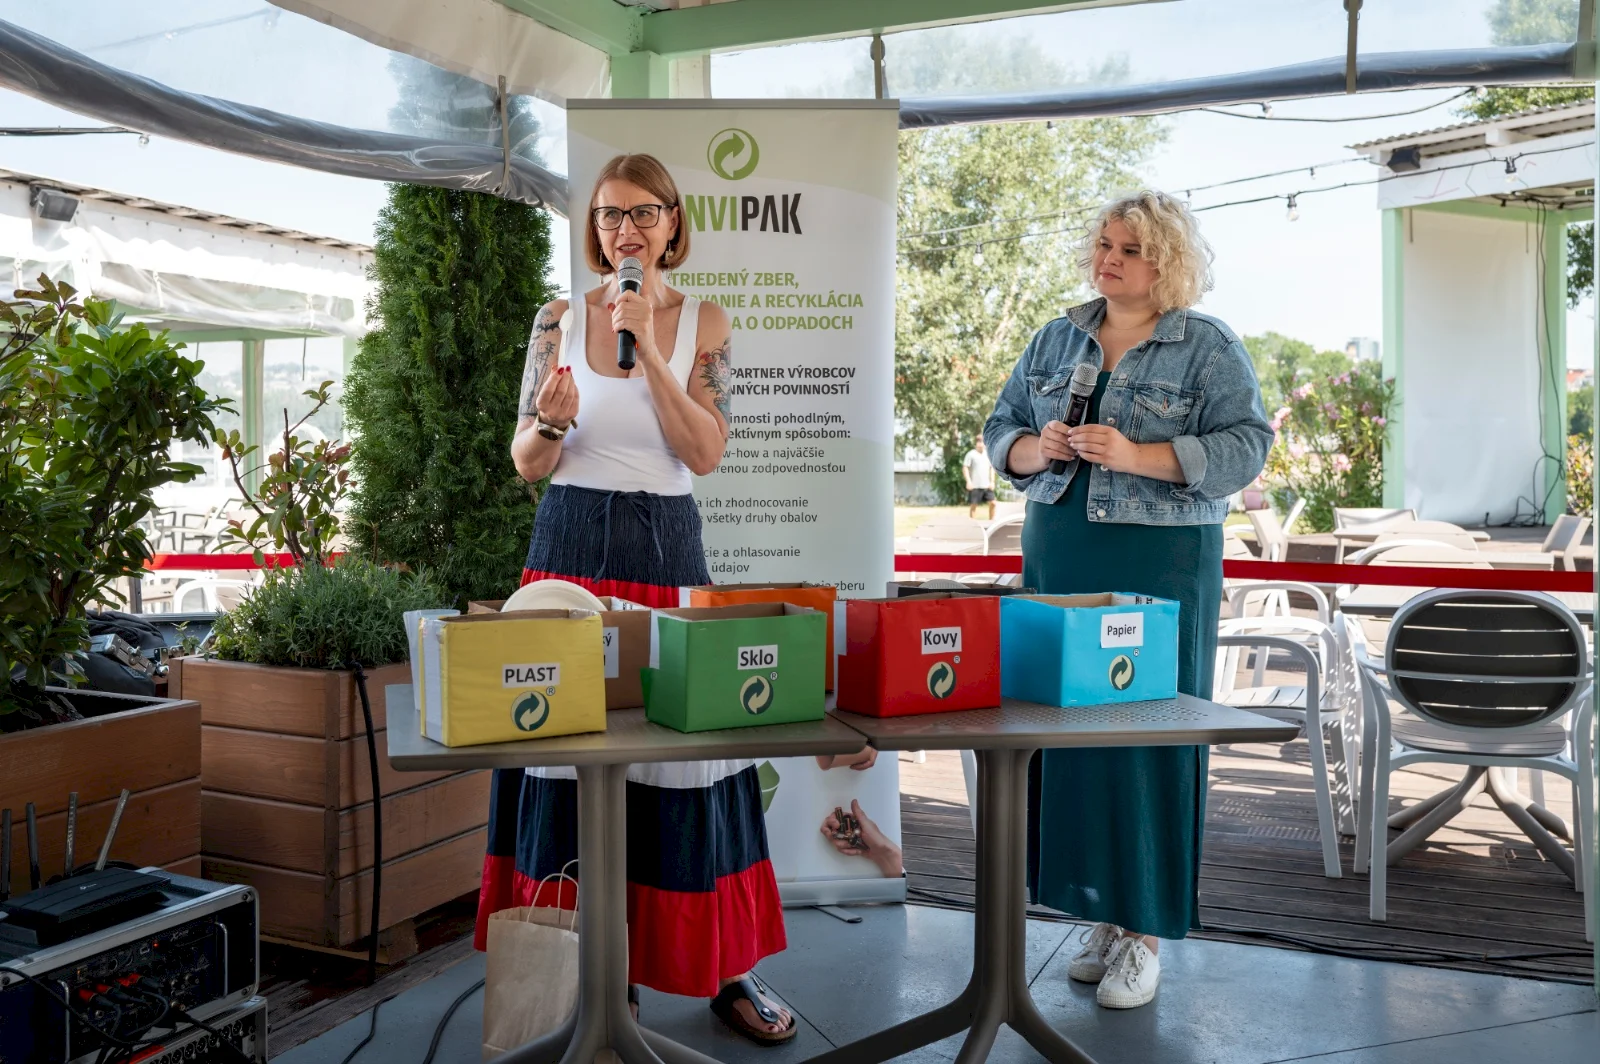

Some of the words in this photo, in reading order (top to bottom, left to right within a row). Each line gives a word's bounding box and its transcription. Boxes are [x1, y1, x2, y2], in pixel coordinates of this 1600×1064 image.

[753, 272, 799, 289] ZBER,
[750, 294, 761, 308] A
[765, 289, 863, 308] RECYKLÁCIA
[746, 315, 758, 330] O
[762, 315, 853, 330] ODPADOCH
[730, 367, 785, 379] PARTNER
[787, 364, 856, 379] VÝROBCOV
[773, 381, 850, 395] POVINNOSTÍ
[774, 412, 845, 427] pohodlným,
[785, 428, 851, 441] spôsobom:
[762, 449, 769, 459] a
[773, 447, 825, 460] najväčšie
[752, 462, 846, 476] zodpovednosťou
[705, 497, 722, 508] ich
[725, 497, 809, 508] zhodnocovanie
[706, 513, 742, 526] všetky
[745, 512, 777, 526] druhy
[780, 512, 818, 523] obalov
[722, 549, 730, 558] a
[733, 546, 801, 558] ohlasovanie
[711, 562, 750, 575] údajov
[834, 580, 865, 591] zberu
[1107, 624, 1137, 638] Papier
[923, 629, 959, 649] Kovy
[739, 649, 774, 667] Sklo
[504, 666, 557, 683] PLAST
